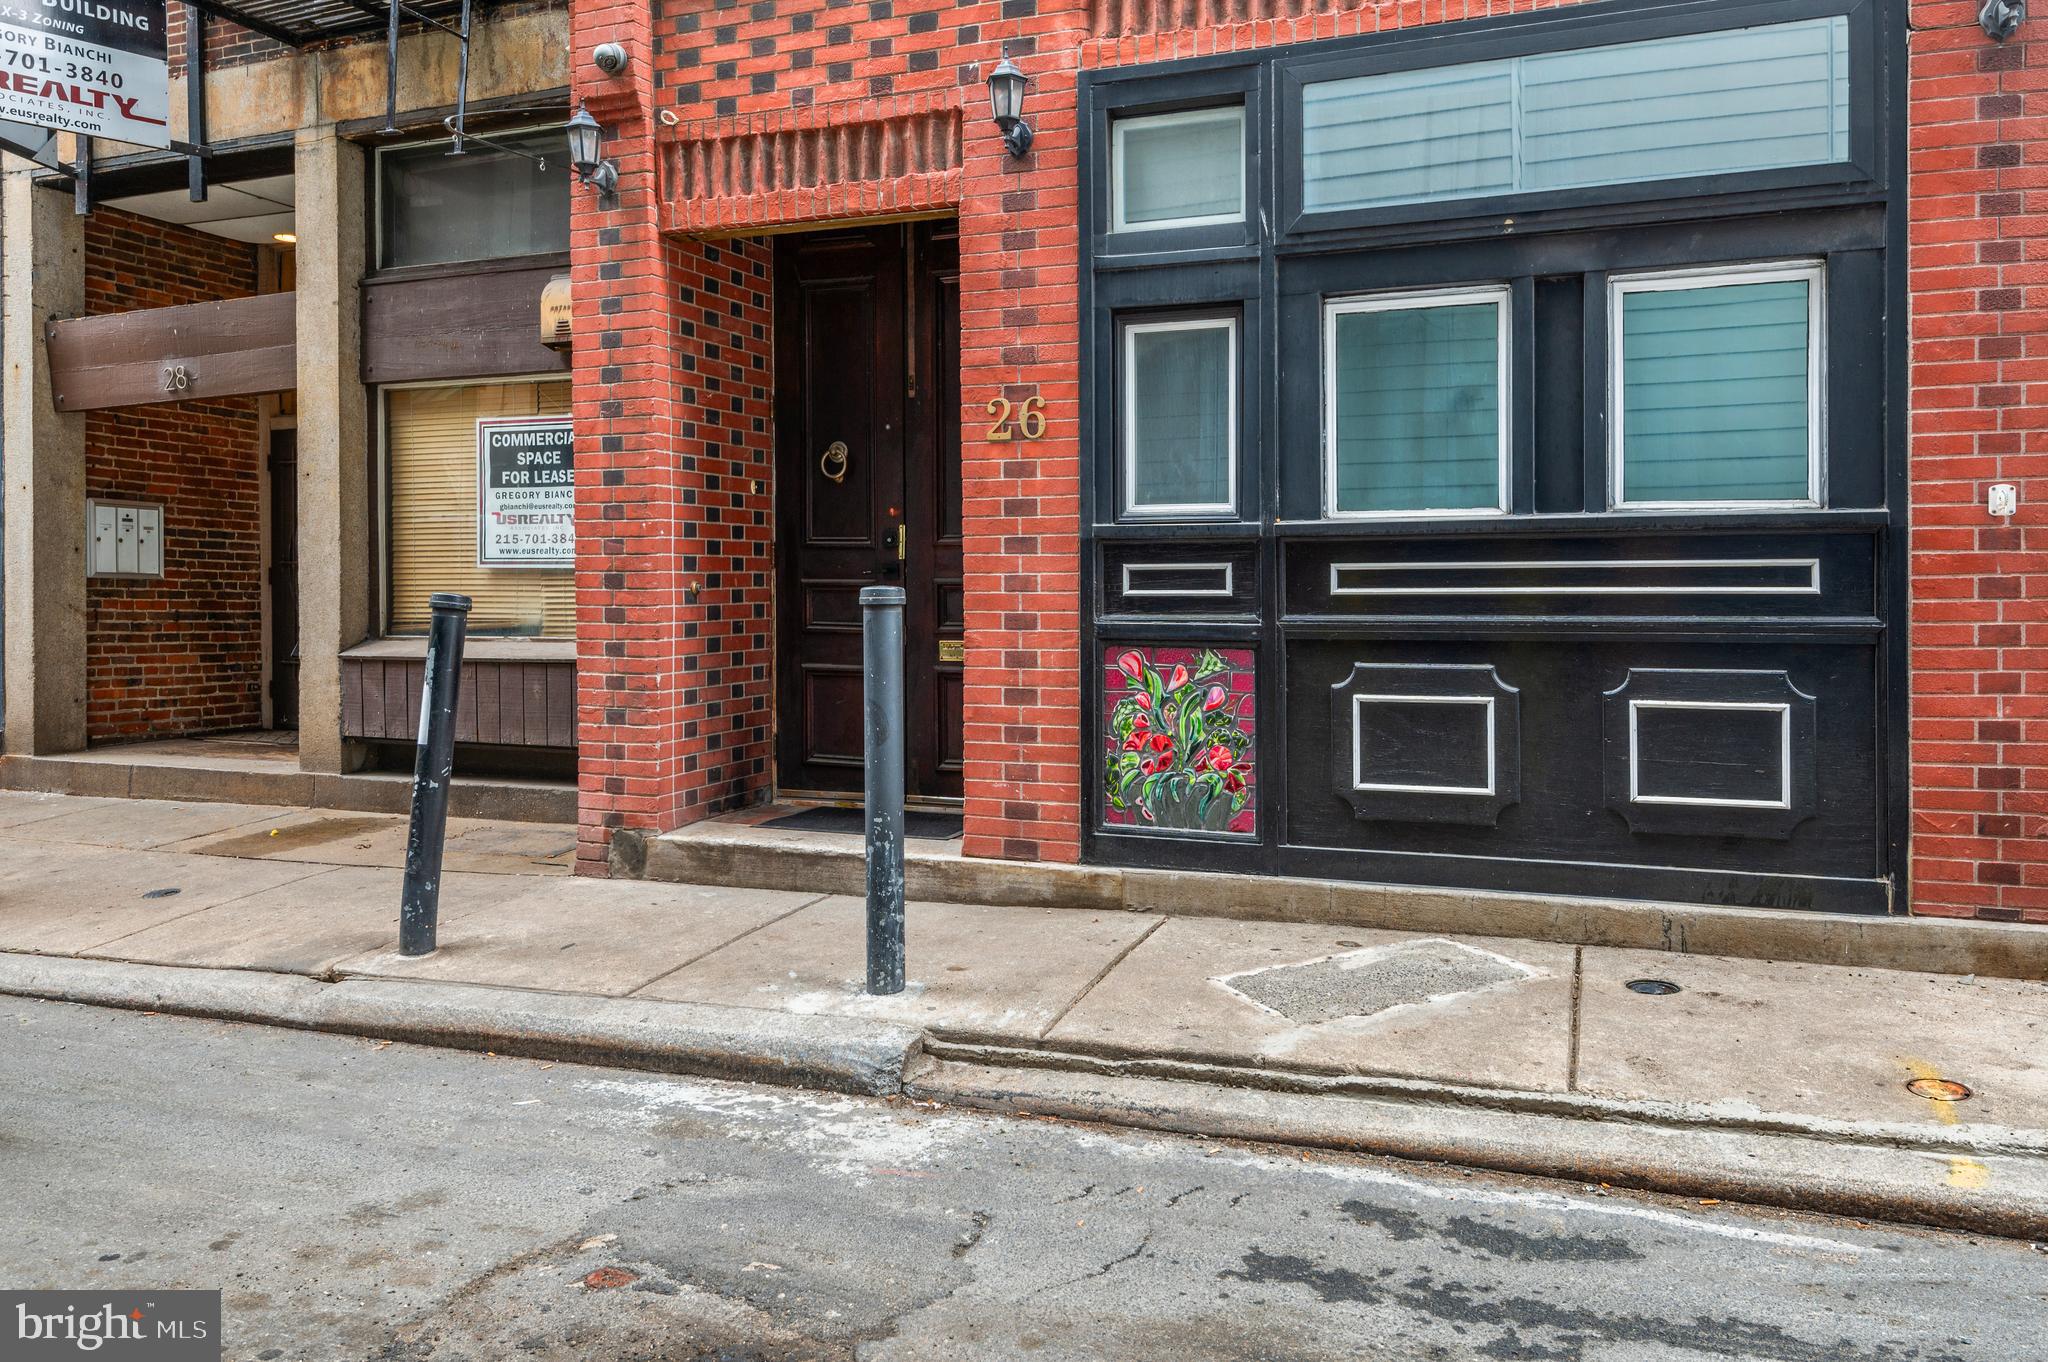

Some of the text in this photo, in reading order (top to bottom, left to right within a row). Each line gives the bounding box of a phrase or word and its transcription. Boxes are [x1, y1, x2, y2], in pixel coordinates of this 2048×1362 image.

[32, 12, 85, 34] ZONING
[45, 37, 112, 64] BIANCHI
[0, 49, 123, 89] 701-3840
[79, 108, 110, 121] INC.
[163, 365, 187, 391] 28
[986, 396, 1046, 441] 26
[517, 451, 561, 466] SPACE
[502, 469, 574, 484] FOR LEASE
[495, 491, 541, 500] GREGORY
